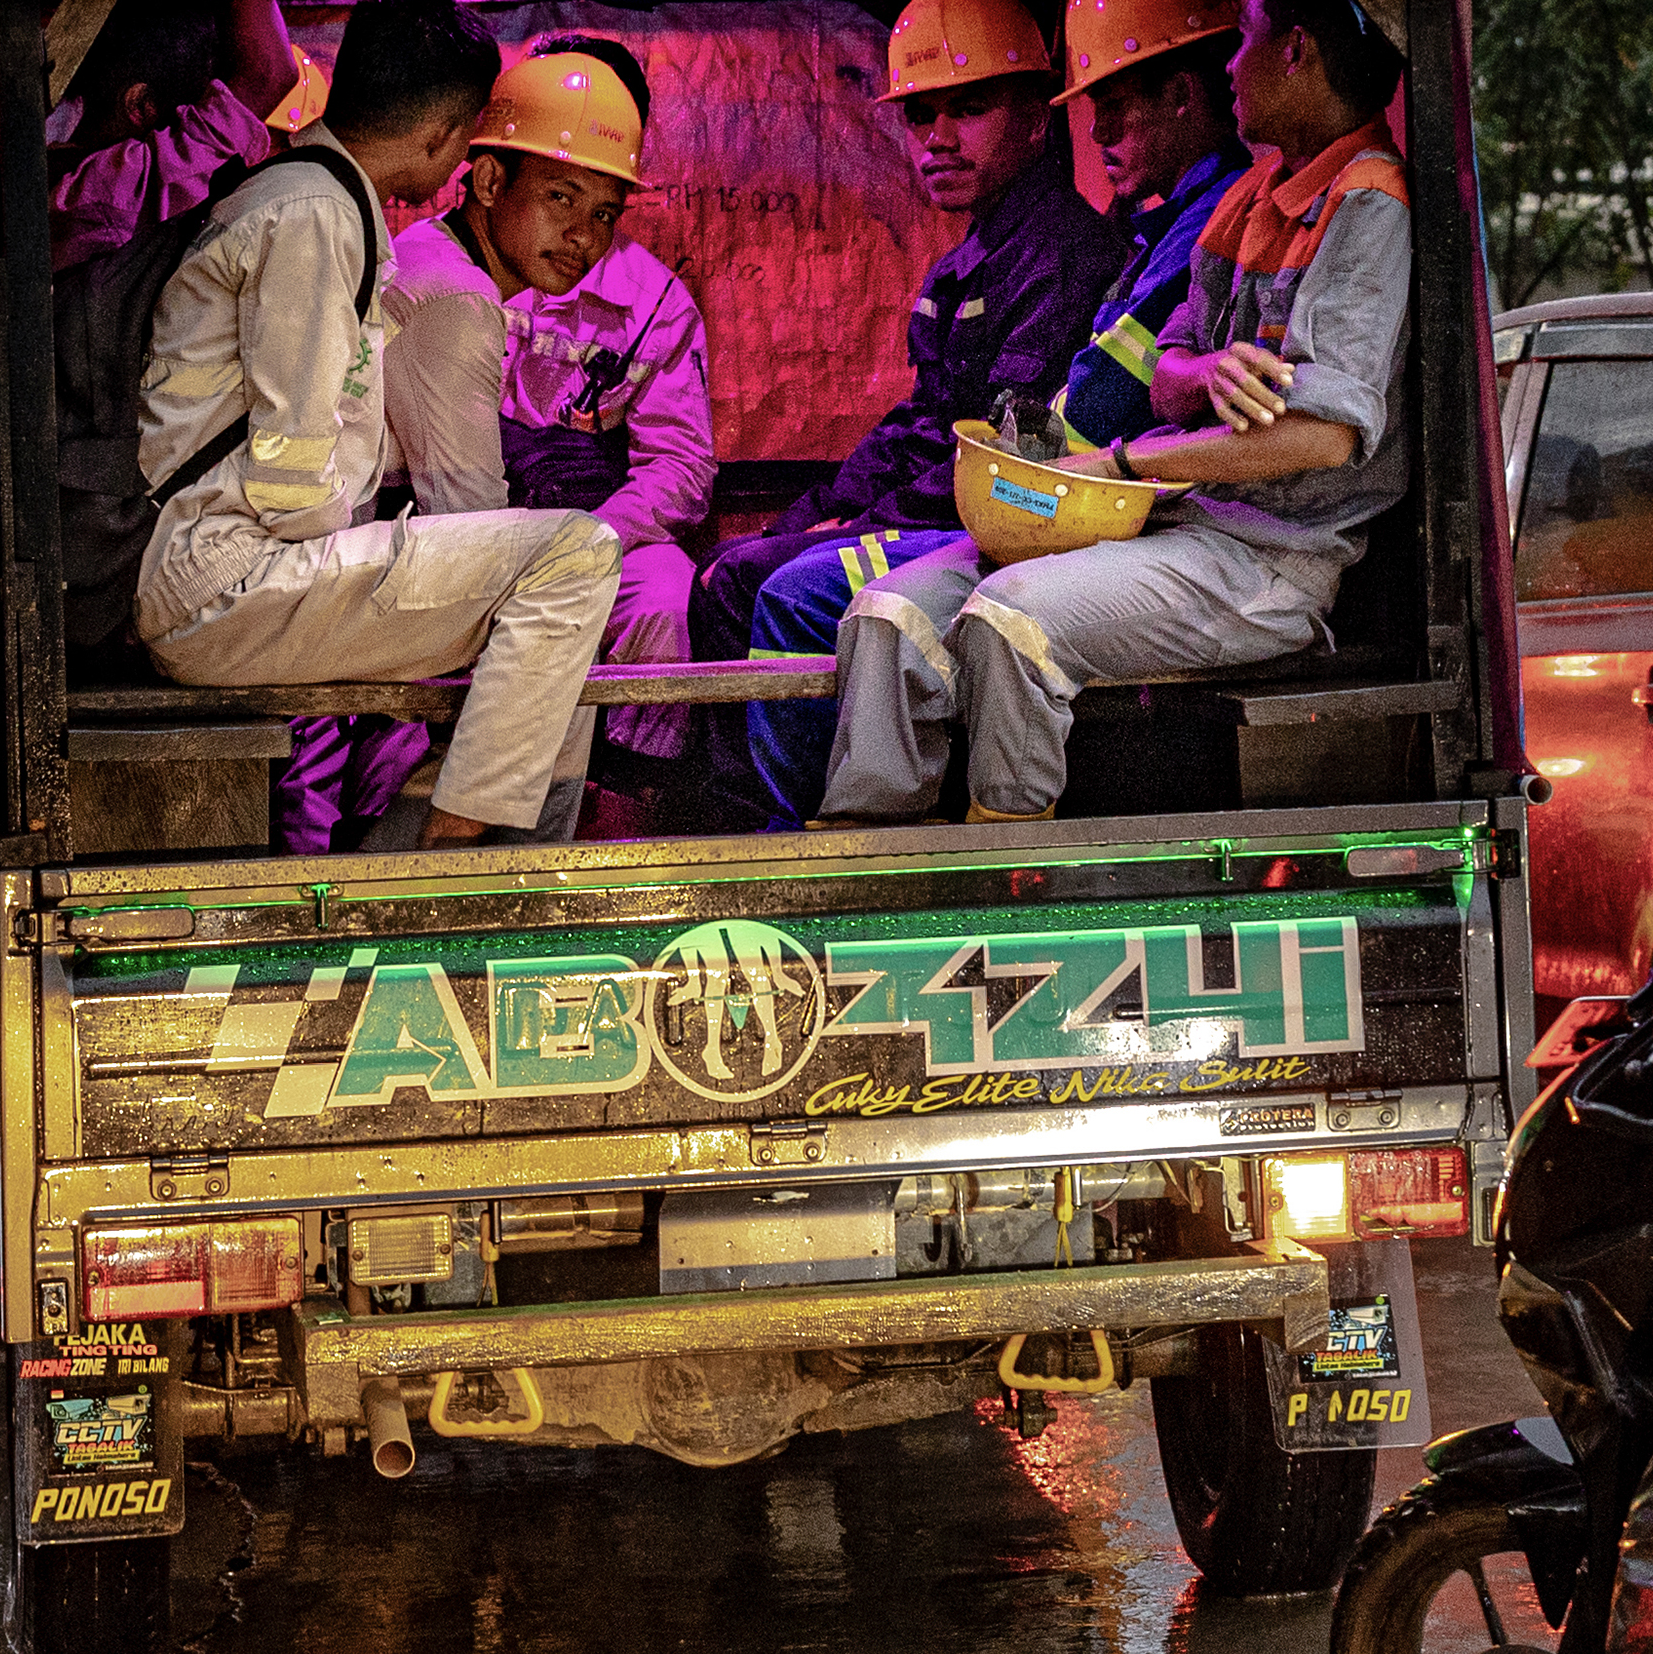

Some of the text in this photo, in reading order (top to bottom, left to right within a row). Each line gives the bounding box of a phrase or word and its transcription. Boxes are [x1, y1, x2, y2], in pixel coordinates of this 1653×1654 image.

[912, 1073, 1042, 1113] Elite
[1180, 1055, 1312, 1093] Sulit
[59, 1344, 158, 1357] TING TING
[57, 1418, 144, 1444] CCTV
[30, 1478, 172, 1524] PONOSO
